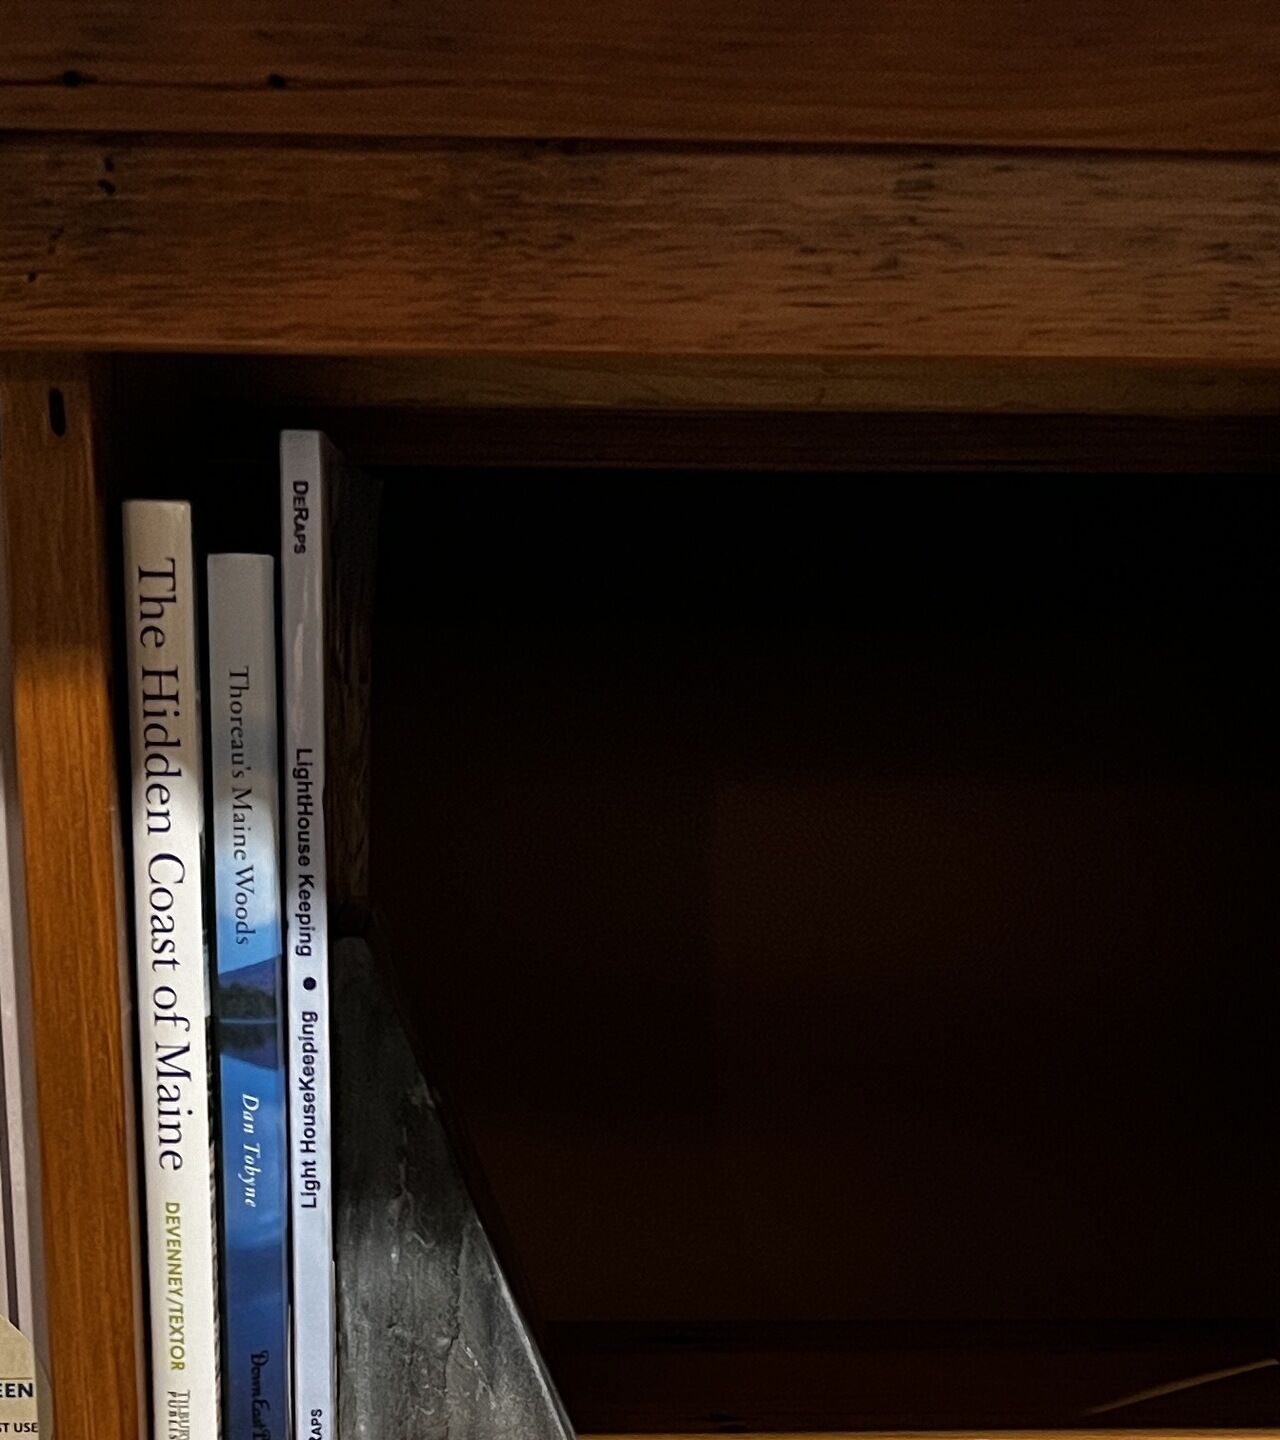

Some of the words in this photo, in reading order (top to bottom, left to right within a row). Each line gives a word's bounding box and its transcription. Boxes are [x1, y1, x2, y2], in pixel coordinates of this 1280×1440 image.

[138, 557, 177, 648] The
[141, 665, 183, 835] Hidden
[229, 665, 252, 779] Thoreau's
[232, 787, 253, 861] Maine
[147, 852, 185, 972] Coast
[233, 865, 256, 945] Woods
[295, 874, 314, 956] Keeping
[152, 985, 191, 1033] of
[155, 1042, 192, 1171] Maine
[241, 1093, 259, 1134] Dan
[237, 1143, 264, 1207] Tobyne
[165, 1201, 185, 1371] DEVENNEY/TEXTOR
